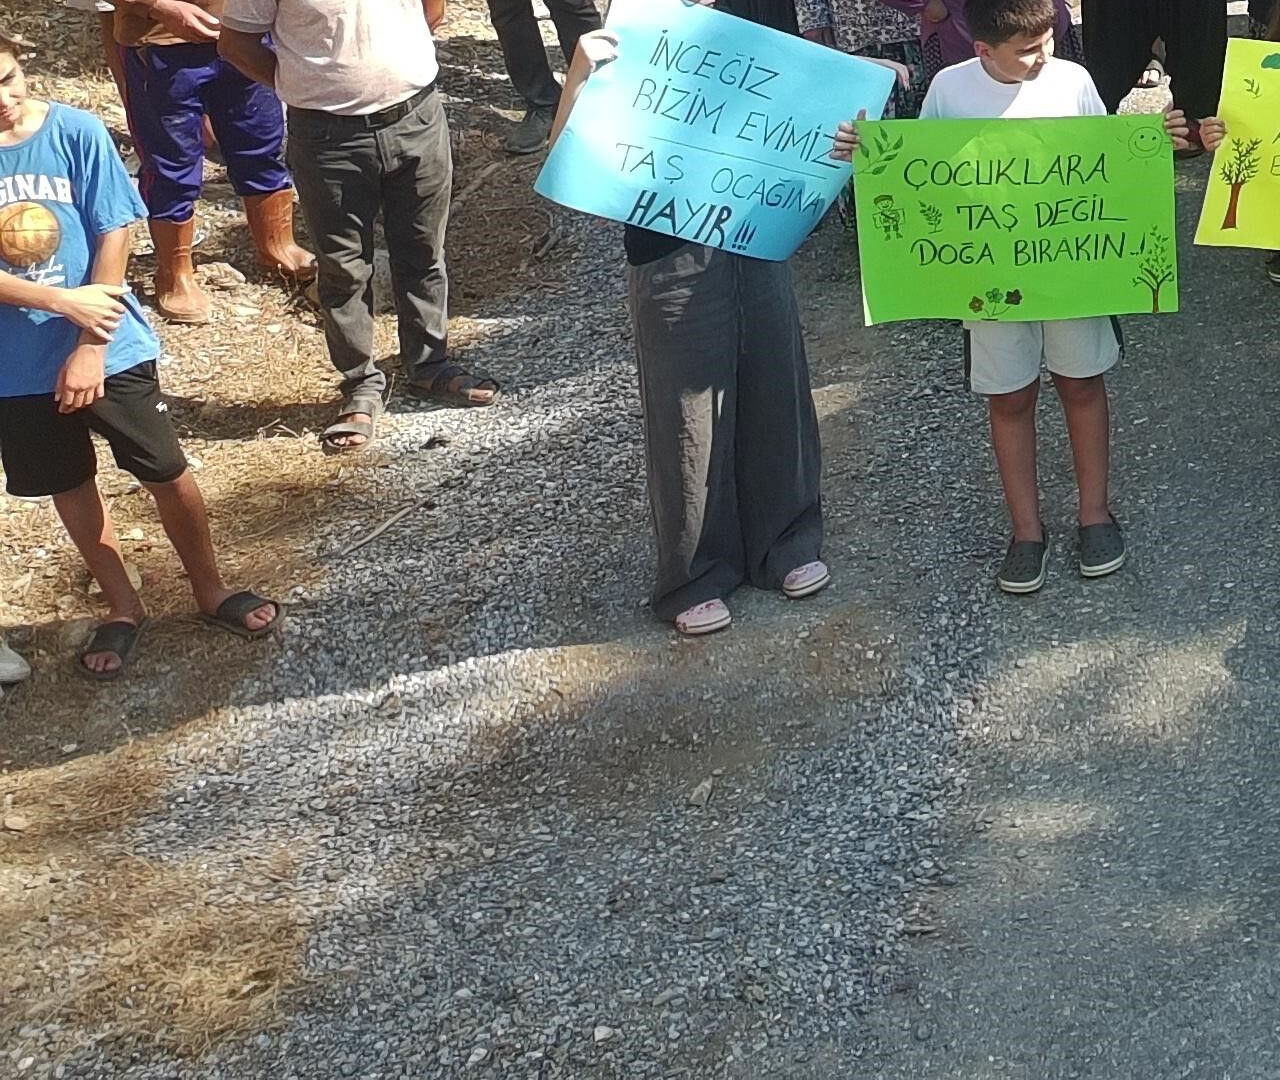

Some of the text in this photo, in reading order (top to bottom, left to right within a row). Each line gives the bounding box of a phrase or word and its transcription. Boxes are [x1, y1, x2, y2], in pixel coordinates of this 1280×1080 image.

[649, 29, 781, 100] İNCEĞİZ
[632, 77, 842, 170] BİZİM EVİMİZ
[615, 142, 824, 217] TAŞ OCAĞINA
[903, 152, 1110, 191] ÇOCUKLARA
[956, 193, 1129, 232] TAŞ DEĞİL
[909, 238, 996, 267] DOĞA
